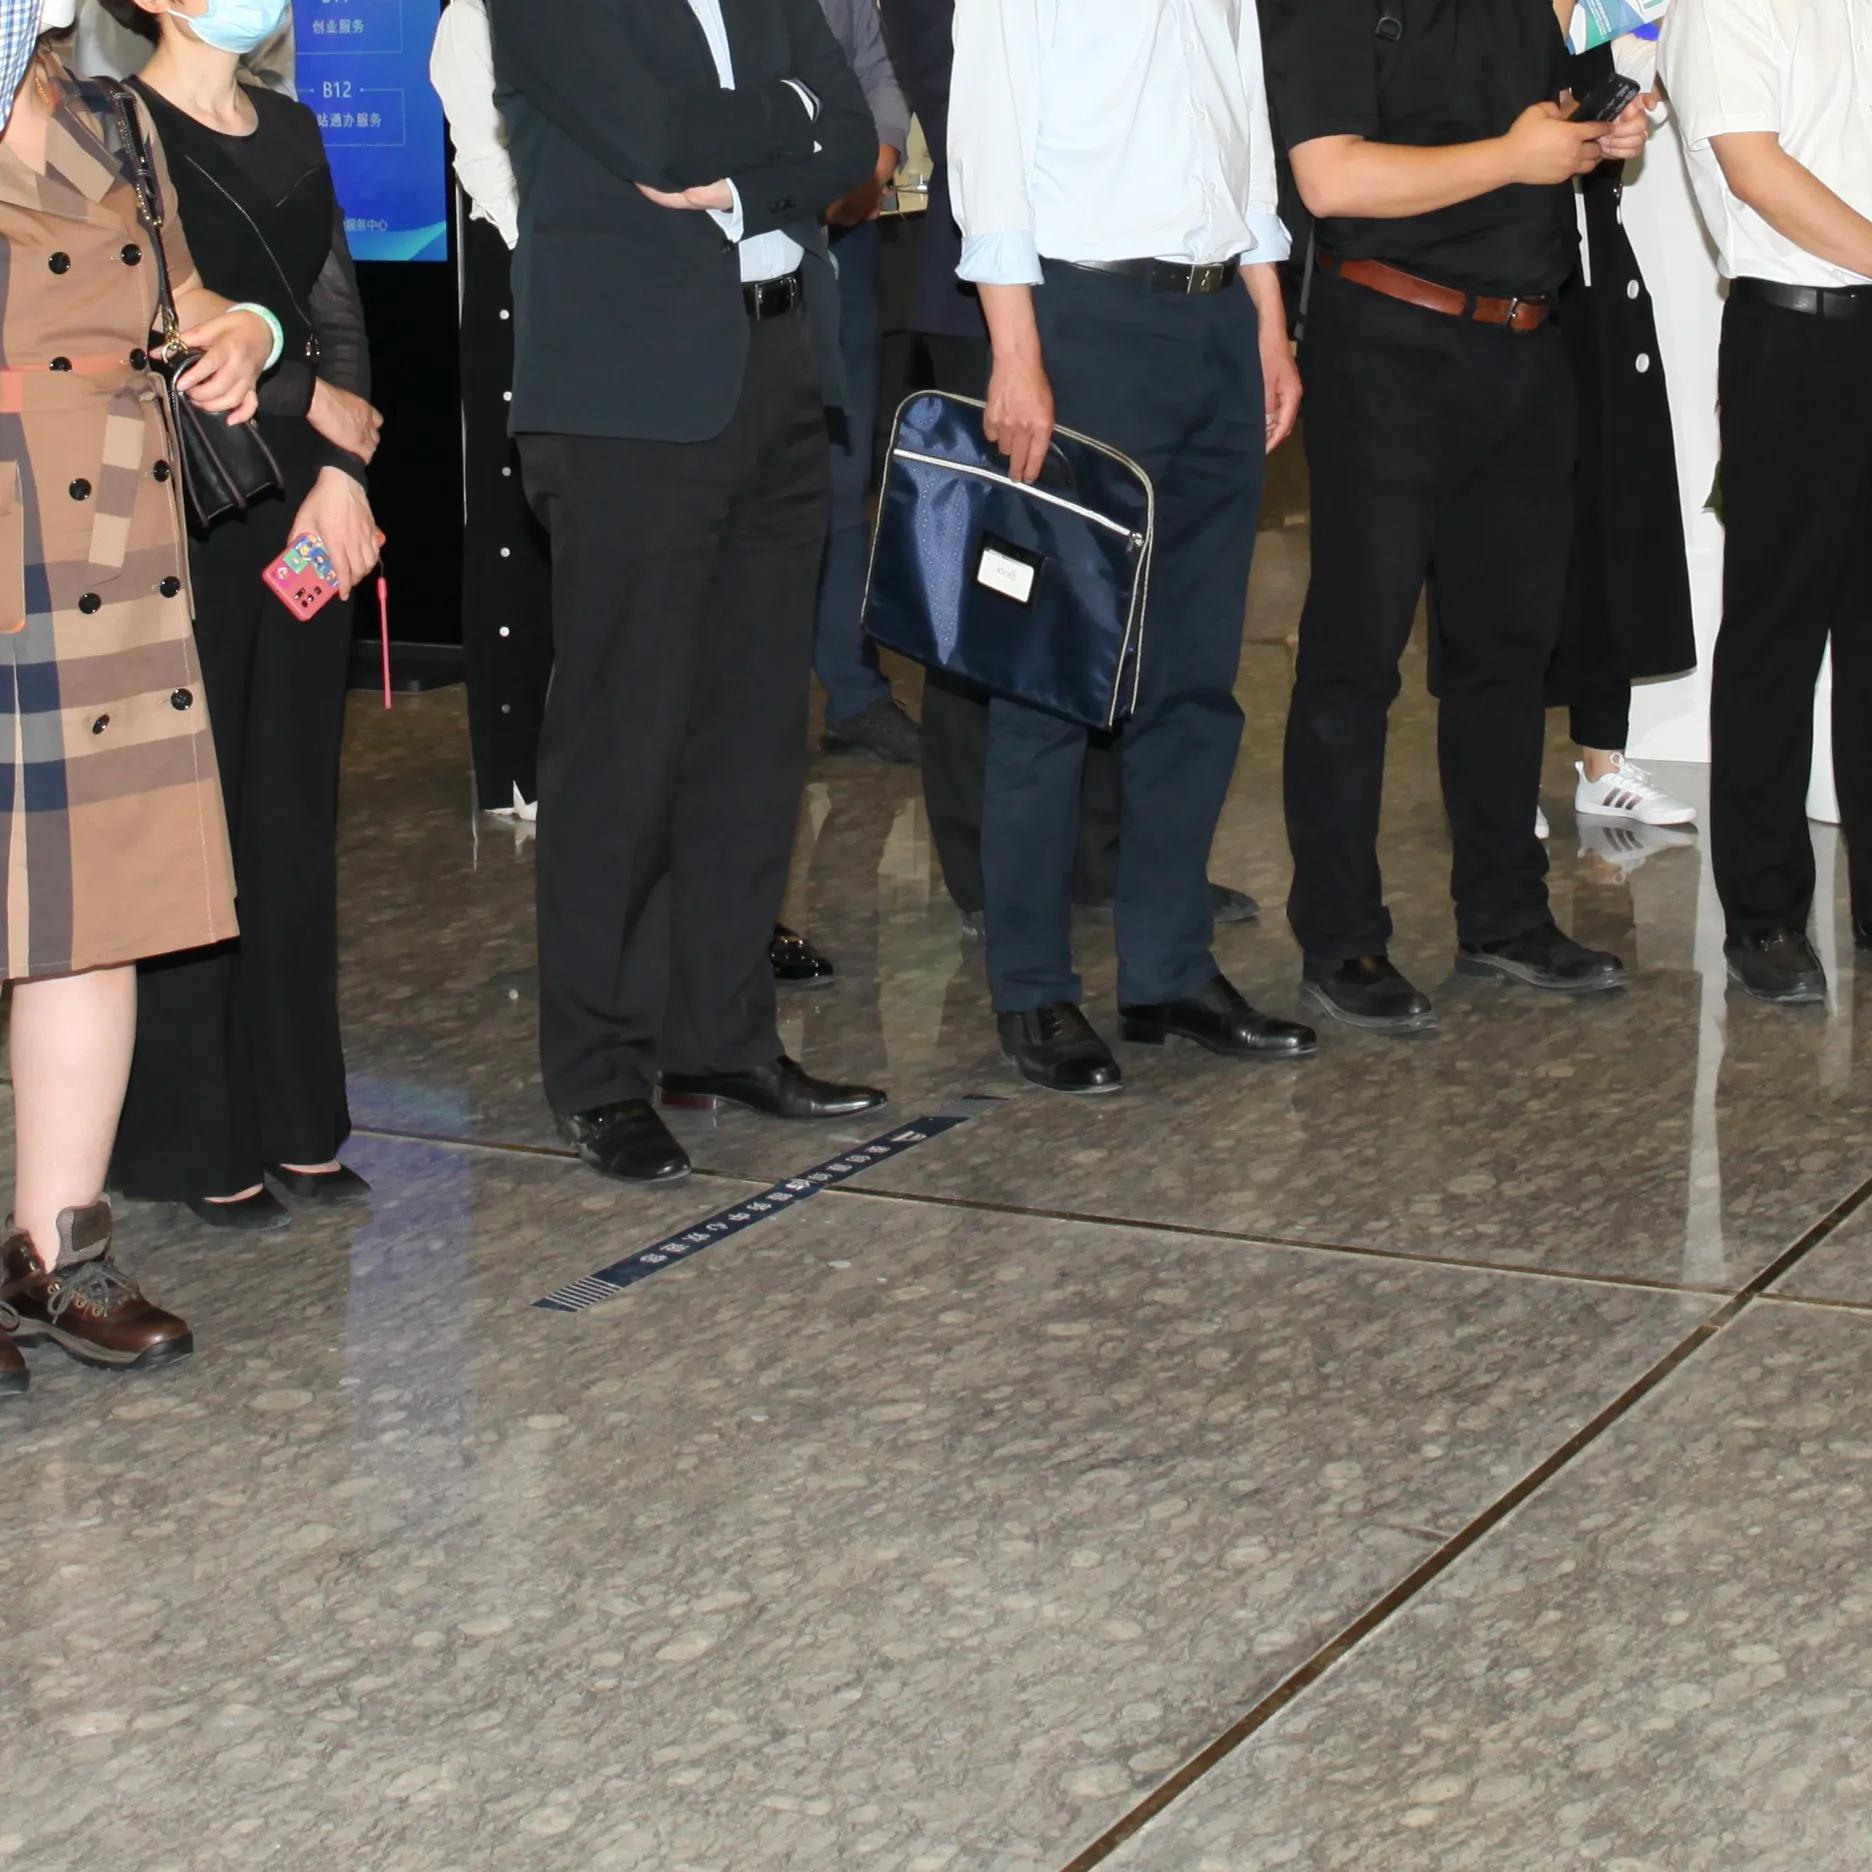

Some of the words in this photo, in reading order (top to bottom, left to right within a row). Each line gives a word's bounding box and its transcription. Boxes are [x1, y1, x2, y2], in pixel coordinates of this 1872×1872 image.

[312, 18, 365, 35] 创业服务
[323, 81, 353, 98] B12
